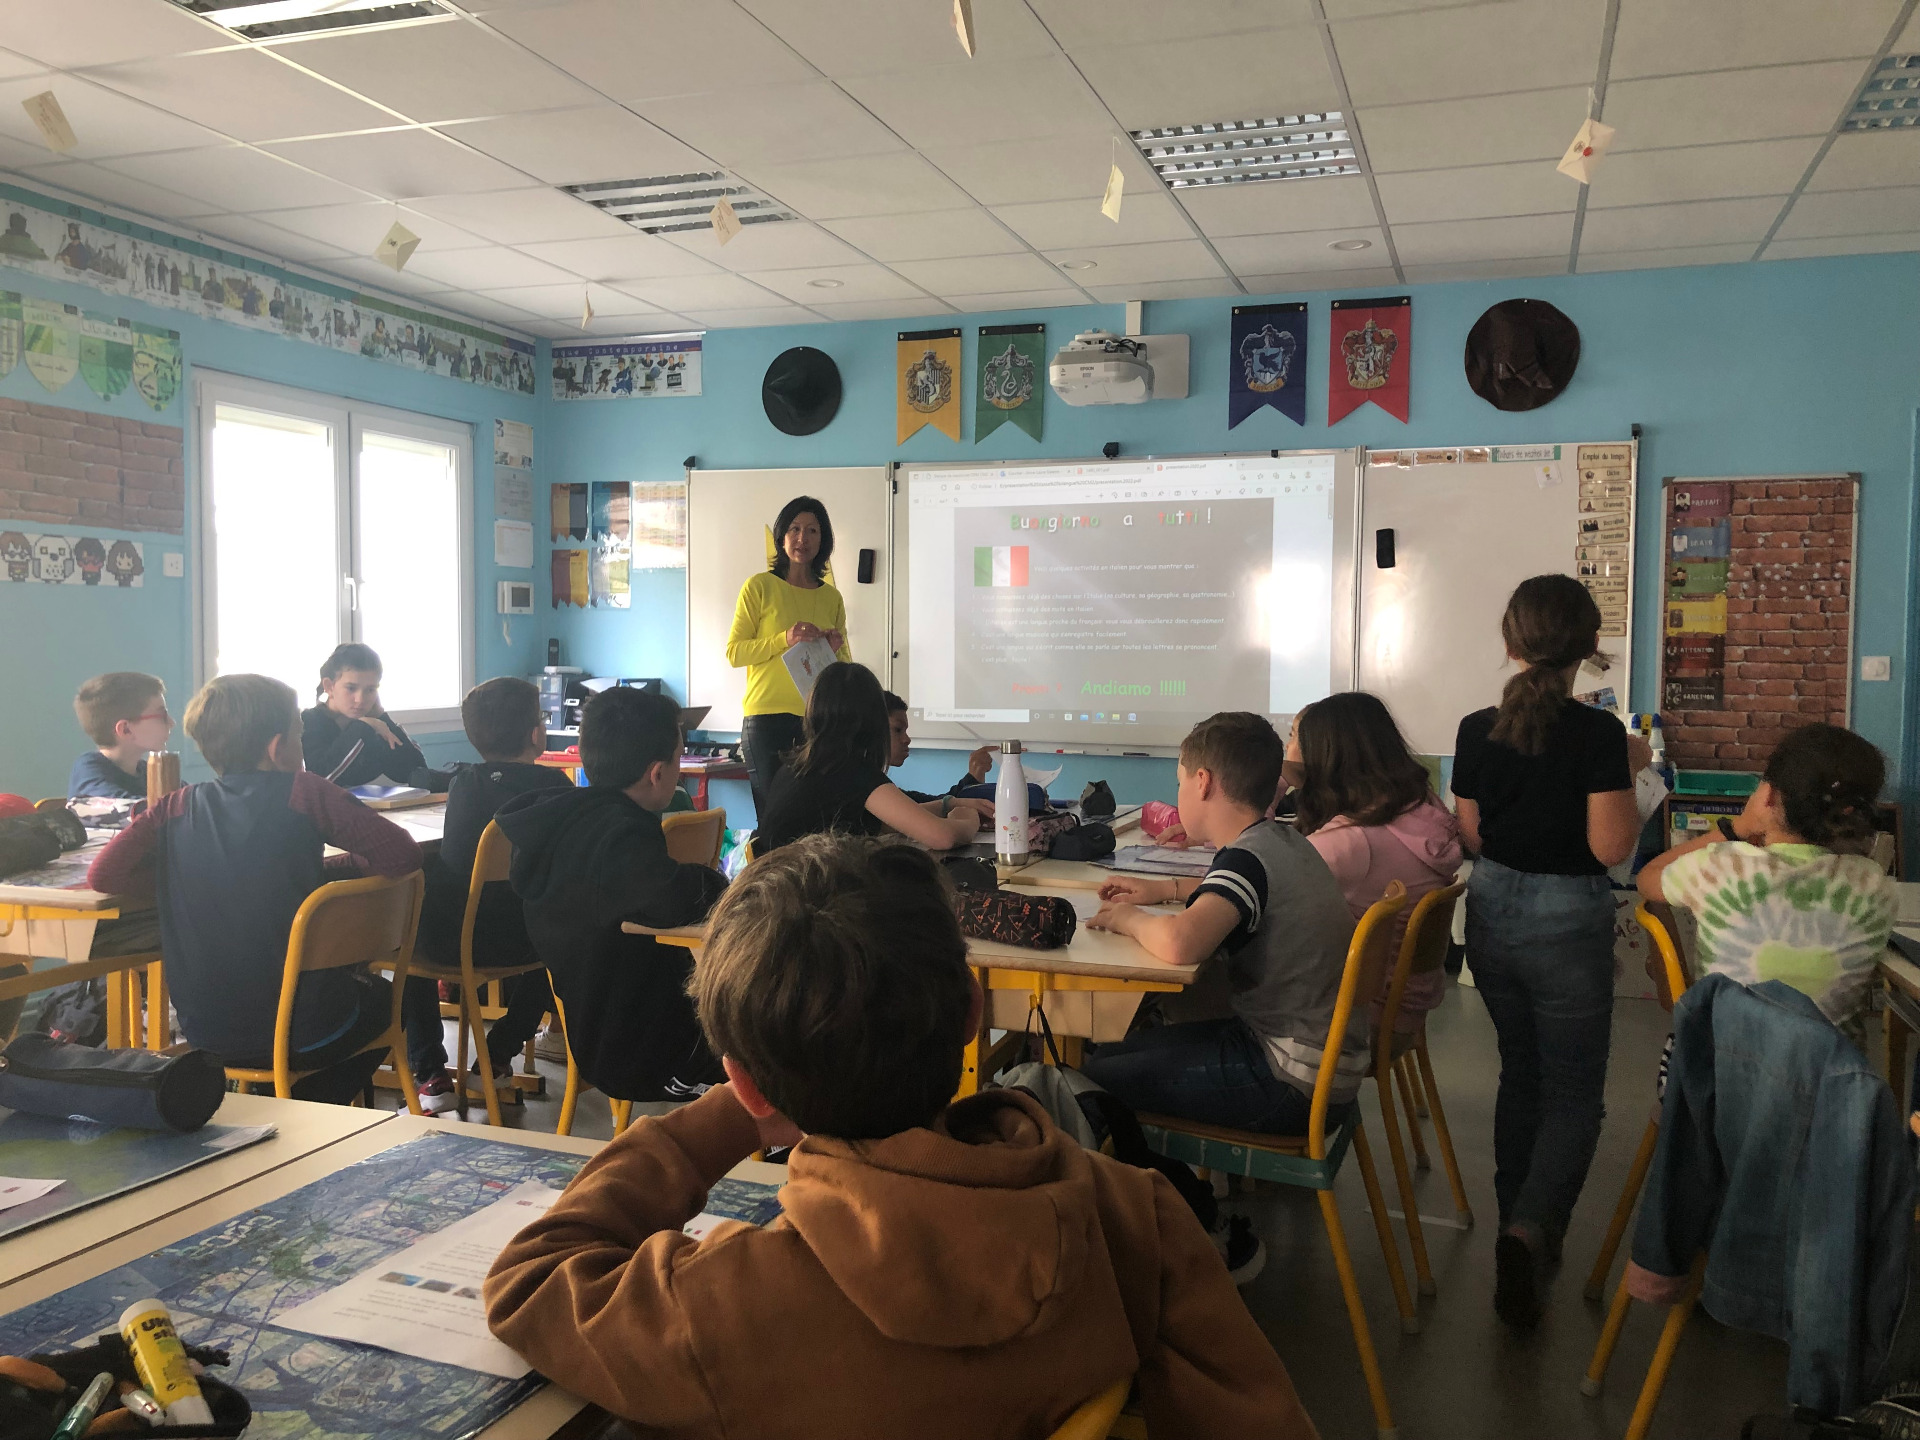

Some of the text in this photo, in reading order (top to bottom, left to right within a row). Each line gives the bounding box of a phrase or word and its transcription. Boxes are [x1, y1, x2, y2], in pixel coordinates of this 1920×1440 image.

[588, 344, 678, 357] Contemporaine
[1582, 453, 1600, 462] Emploi
[1611, 453, 1625, 462] temps
[1010, 506, 1212, 533] Buongiorno a tutti !
[1146, 591, 1181, 600] géographie,
[1049, 618, 1068, 626] proche
[1079, 680, 1186, 696] Andiamo !!!!!!
[1683, 693, 1715, 701] SANCTION
